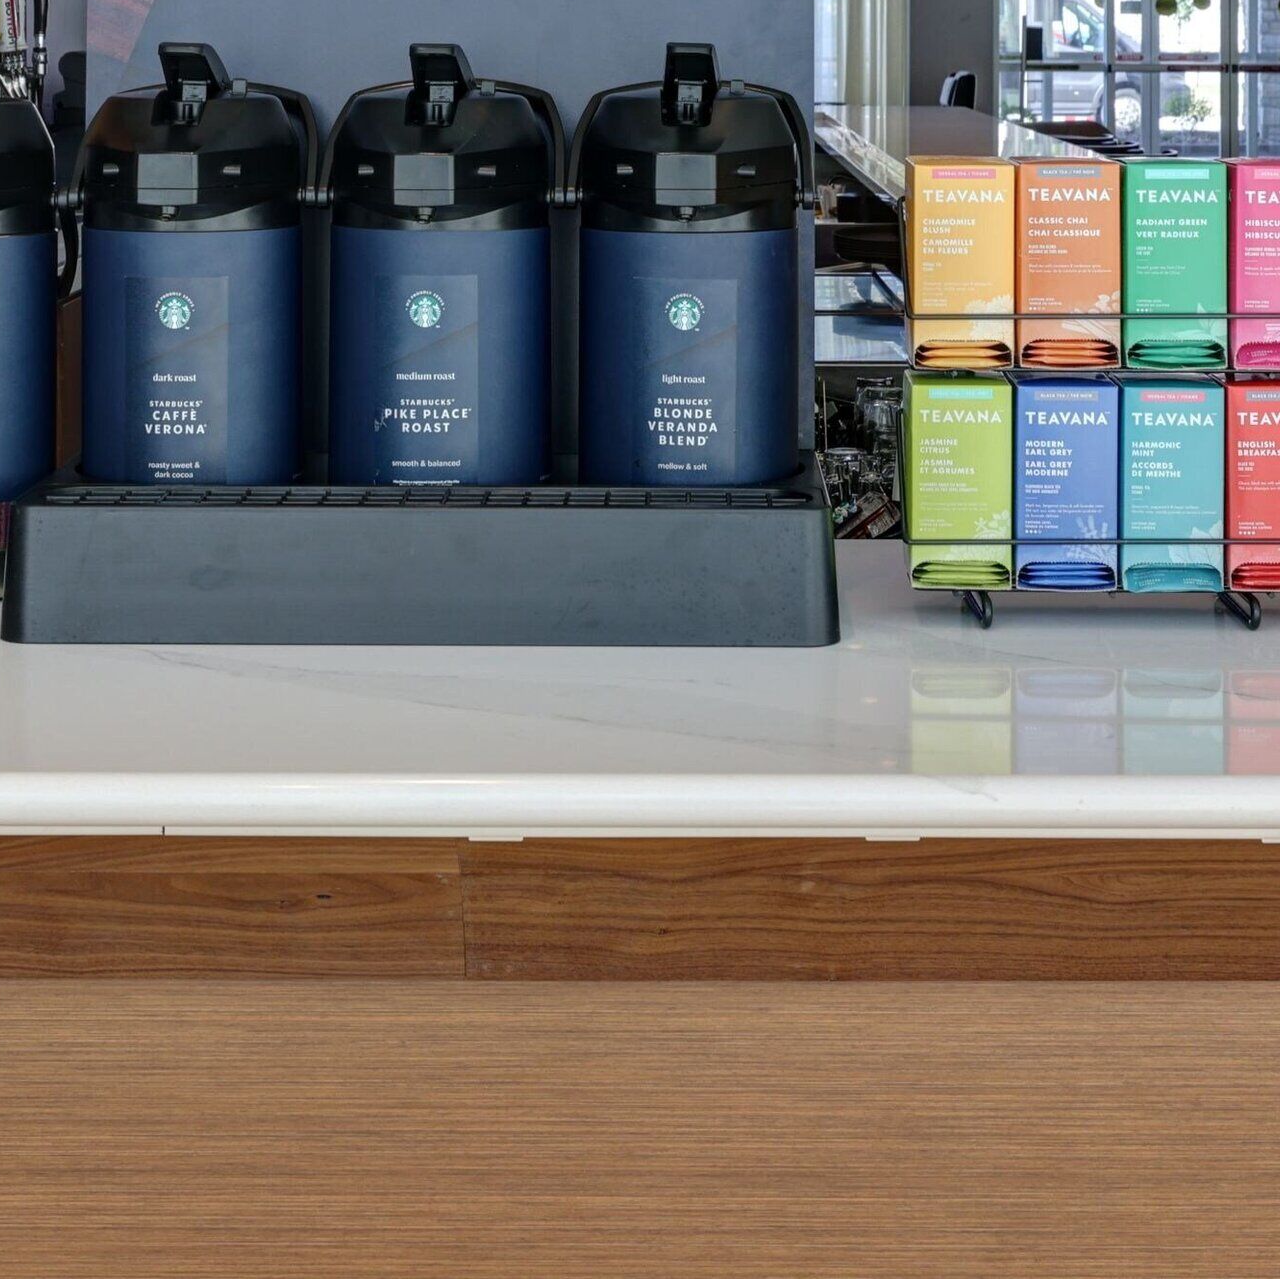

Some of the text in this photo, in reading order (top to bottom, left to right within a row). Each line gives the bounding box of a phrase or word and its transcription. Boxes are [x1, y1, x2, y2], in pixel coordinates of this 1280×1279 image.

[1028, 216, 1089, 225] CLASSIC CHAI
[1136, 218, 1208, 226] RADIANT GREEN
[1028, 229, 1101, 238] CHAI CLASSIQUE
[152, 374, 197, 382] dark roast
[396, 372, 432, 380] medium
[662, 374, 706, 384] light roast
[152, 408, 197, 421] CAFFÈ
[384, 408, 416, 419] PIKE
[654, 408, 712, 419] BLONDE
[402, 422, 450, 433] ROAST
[648, 420, 718, 432] VERANDA
[920, 438, 958, 446] JASMINE
[1025, 440, 1064, 448] MODERN
[148, 462, 170, 470] roasty
[392, 460, 419, 468] smooth
[428, 460, 461, 468] balanced
[658, 462, 684, 470] mellow
[693, 463, 708, 471] soft
[1132, 462, 1174, 470] ACCORDS
